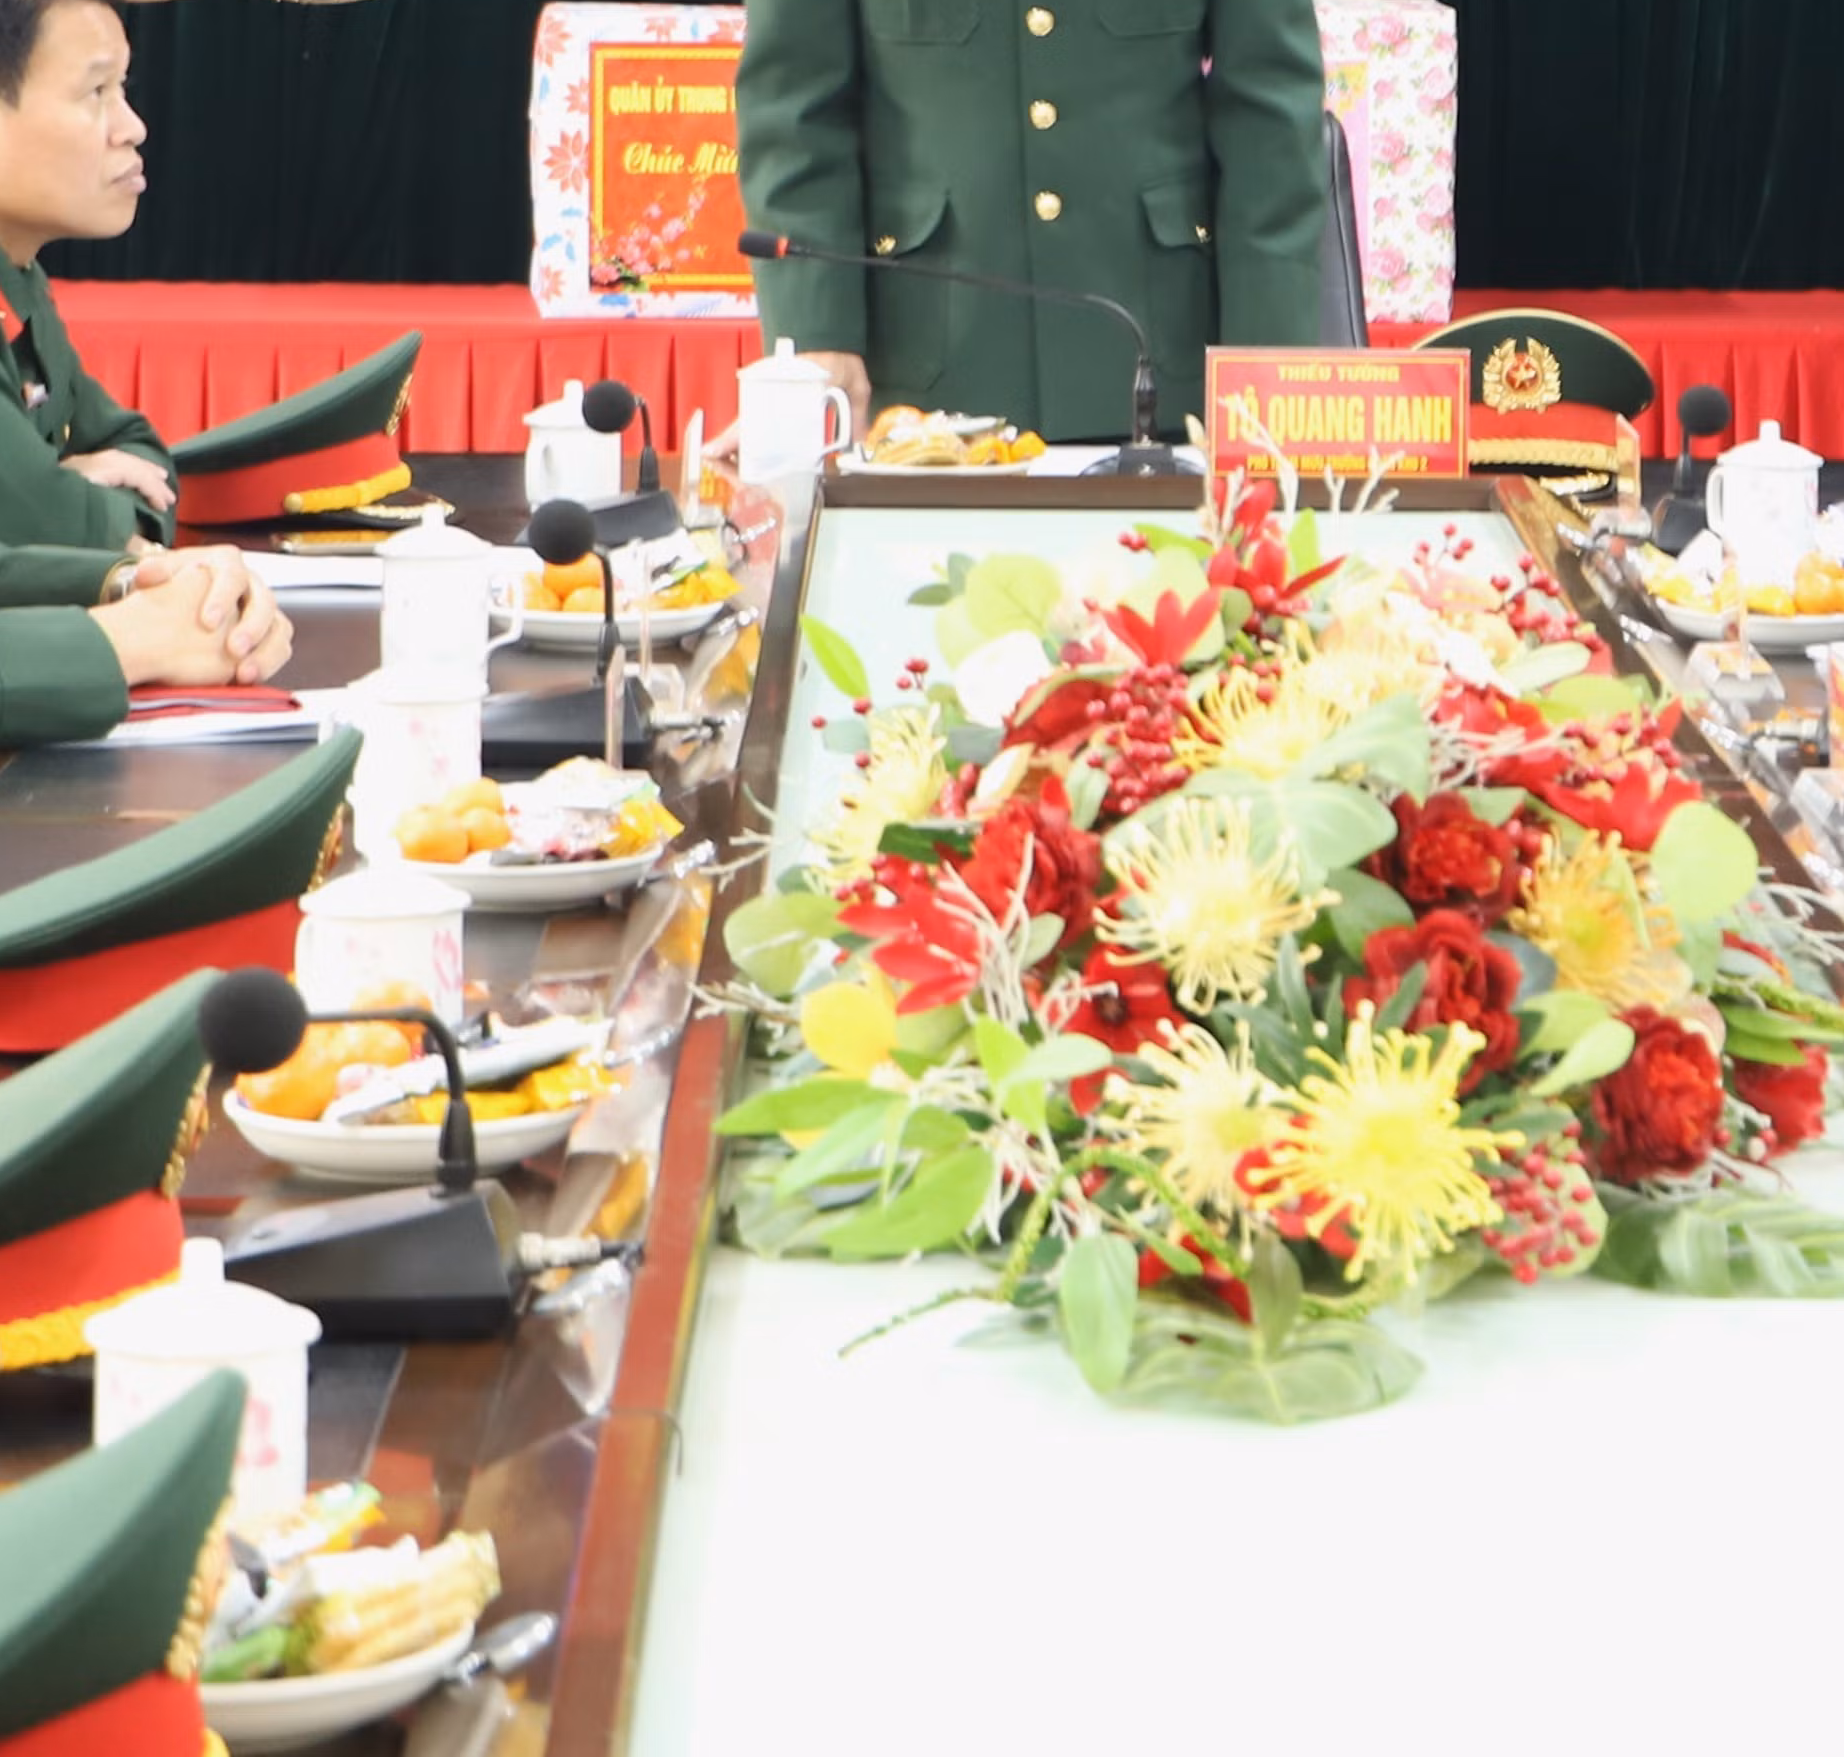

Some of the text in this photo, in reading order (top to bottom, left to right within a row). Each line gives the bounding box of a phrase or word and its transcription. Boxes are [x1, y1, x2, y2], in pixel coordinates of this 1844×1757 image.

[623, 141, 739, 175] Chúc Mừ
[1267, 394, 1365, 447] QUANG
[1373, 395, 1453, 444] HANH
